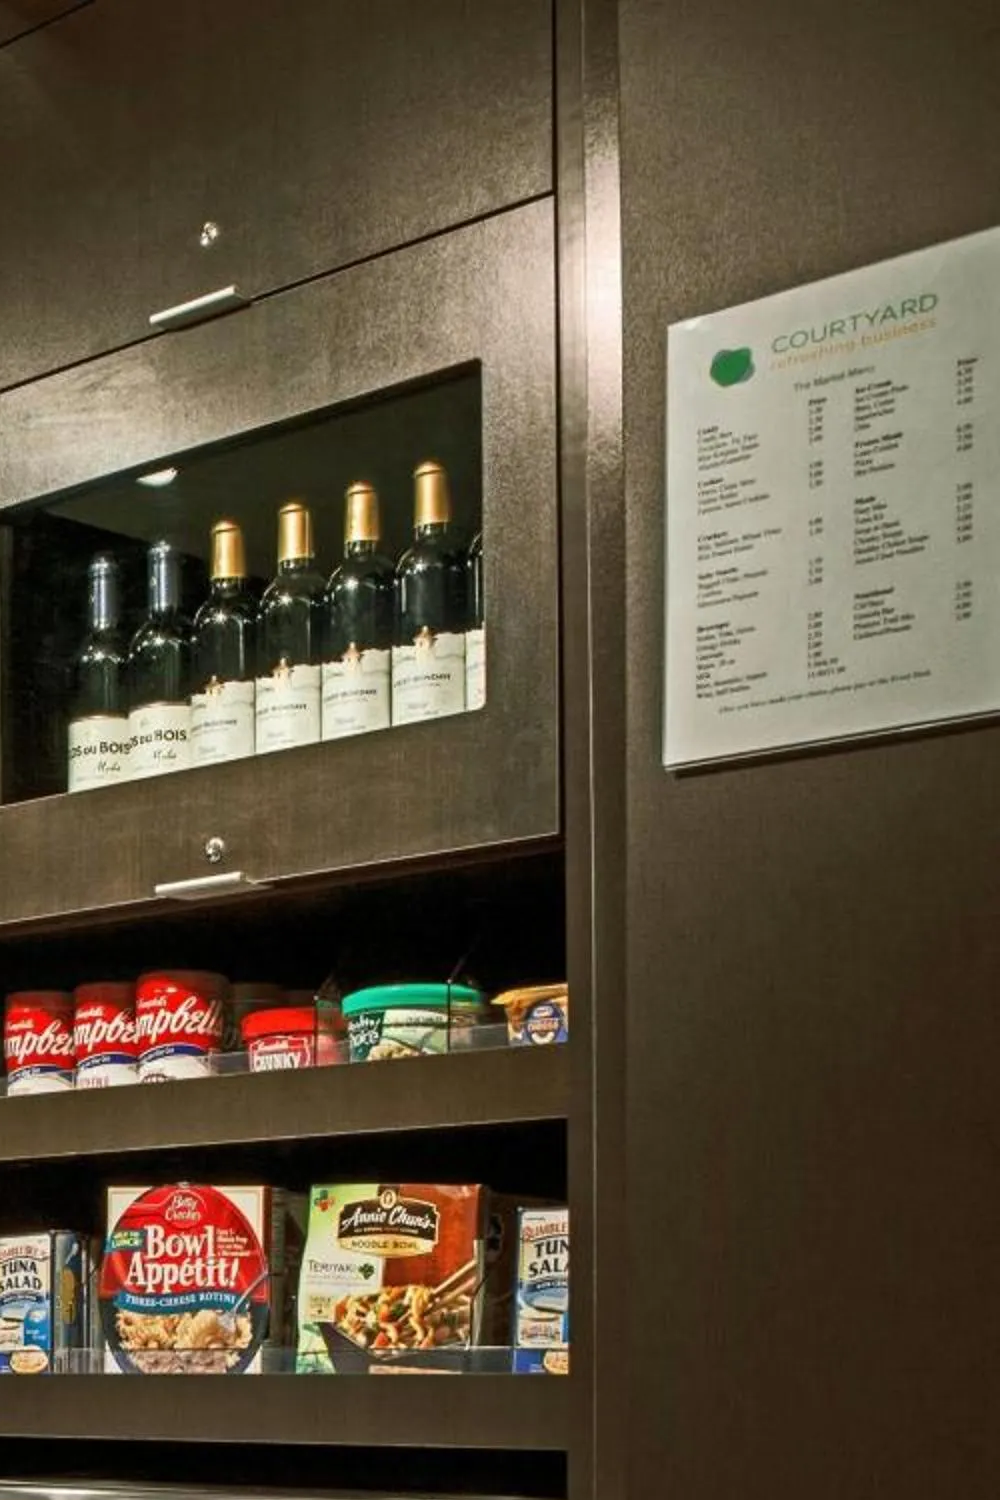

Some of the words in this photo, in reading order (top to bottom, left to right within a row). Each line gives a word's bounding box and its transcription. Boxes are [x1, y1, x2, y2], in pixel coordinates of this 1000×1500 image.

[771, 293, 939, 353] COURTYARD
[153, 729, 187, 742] BOIS
[341, 1205, 388, 1234] Annie
[143, 1223, 216, 1259] Bowl
[1, 1259, 37, 1277] TUNA
[124, 1251, 240, 1293] Appétit!
